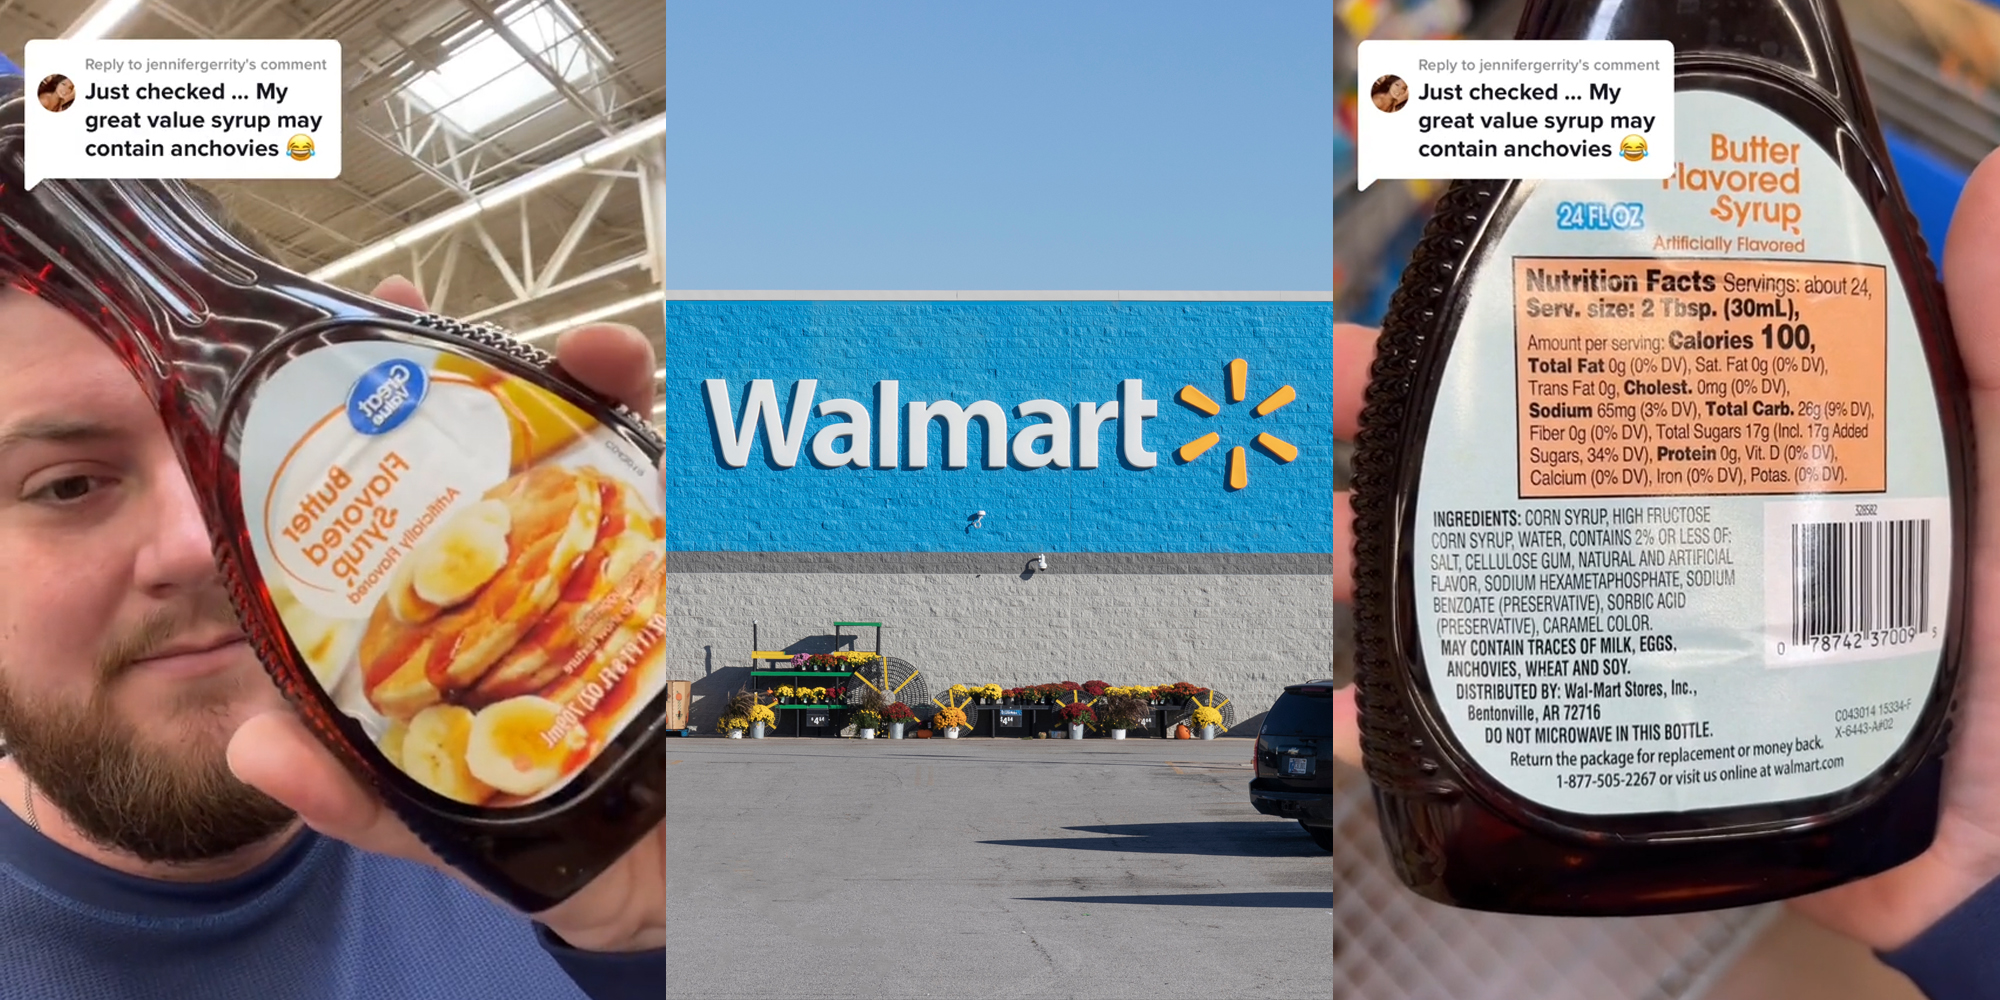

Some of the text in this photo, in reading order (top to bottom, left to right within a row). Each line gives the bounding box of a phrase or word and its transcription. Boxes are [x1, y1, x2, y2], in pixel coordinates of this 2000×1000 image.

[1711, 134, 1800, 165] Butter
[1557, 202, 1643, 230] 24 FL OZ
[1710, 195, 1800, 236] Syrup
[1654, 235, 1805, 254] Artificially Flavored
[1526, 268, 1872, 299] Nutrition Facts Servings: about 24,
[1527, 298, 1799, 322] Serv. size: 2 Tbsp. (30mL),
[1528, 324, 1815, 355] Amount per serving: Calories 100,
[705, 378, 1158, 468] Walmart
[1529, 401, 1873, 421] Sodium 65mg (3% DV), Total Carb. 26g (9% DV),
[1434, 506, 1710, 527] INGREDIENTS: CORN SYRUP, HIGH FRUCTOSE
[1432, 528, 1731, 550] CORN SYRUP, WATER, CONTAINS 2% OR LESS OF:
[1431, 548, 1732, 572] SALT, CELLULOSE GUM, NATURAL AND ARTIFICIAL
[1432, 570, 1735, 594] FLAVOR, SODIUM HEXAMETAPHOSPHATE, SODIUM
[1434, 592, 1686, 615] BENZOATE (PRESERVATIVE), SORBIC ACID
[1437, 615, 1652, 637] (PRESERVATIVE), CARAMEL COLOR.
[1441, 640, 1466, 656] MAY
[1471, 639, 1523, 656] CONTAIN
[1528, 638, 1576, 655] TRACES
[1581, 637, 1596, 653] OF
[1601, 636, 1636, 655] MILK,
[1777, 627, 1937, 655] 0 78742 37009 5
[1448, 658, 1630, 679] ANCHOVIES, WHEAT AND SOY.
[1456, 679, 1697, 700] DISTRIBUTED BY: Wal-Mart Stores, Inc.,
[1469, 704, 1601, 724] Bentonville, AR 72716
[1485, 721, 1713, 744] DO NOT MICROWAVE IN THIS BOTTLE.
[1510, 735, 1824, 770] Return the package for replacement or money back.
[1556, 756, 1844, 789] 1-877-505-2267 or visit us online at walmart.com
